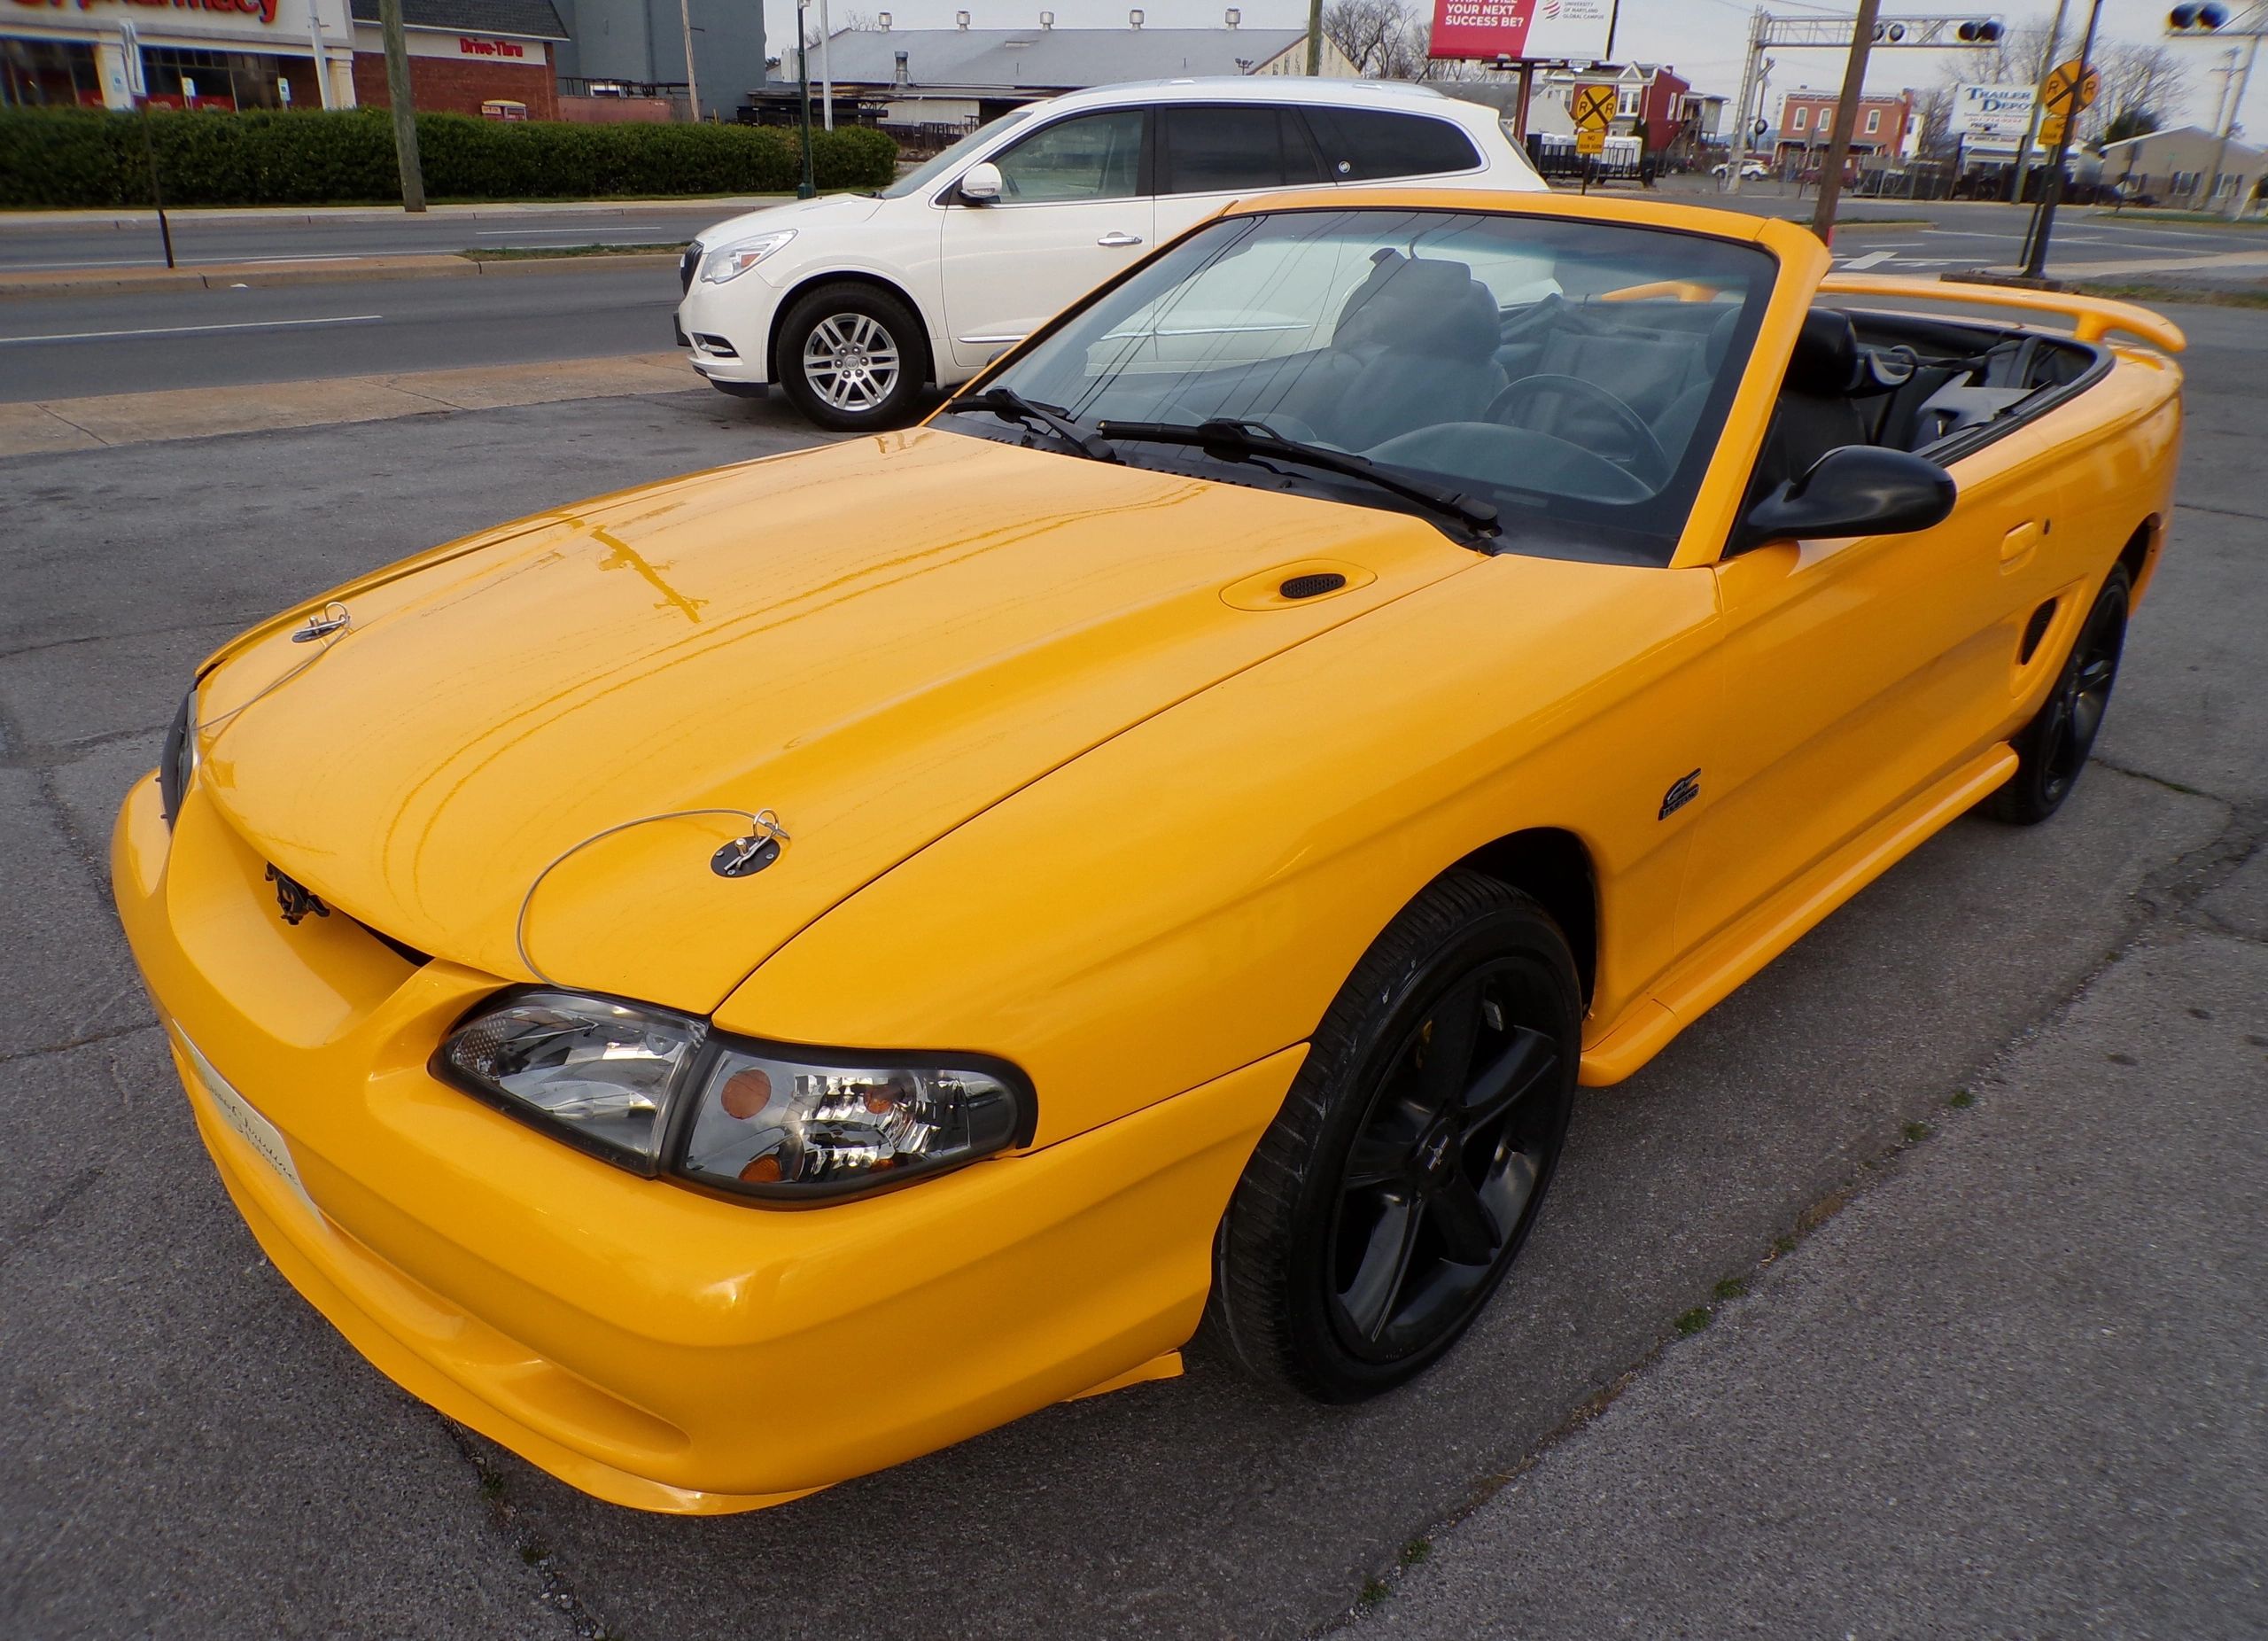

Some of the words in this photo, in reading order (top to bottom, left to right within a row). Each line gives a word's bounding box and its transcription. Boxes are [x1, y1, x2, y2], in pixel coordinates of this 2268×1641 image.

[1447, 4, 1480, 14] YOUR
[1482, 4, 1515, 15] NEXT
[1445, 15, 1498, 27] SUCCESS
[1501, 17, 1525, 27] BE?
[460, 38, 523, 57] Drive-Thru
[1965, 87, 2031, 100] TRAILER
[1982, 99, 2036, 112] DEPO
